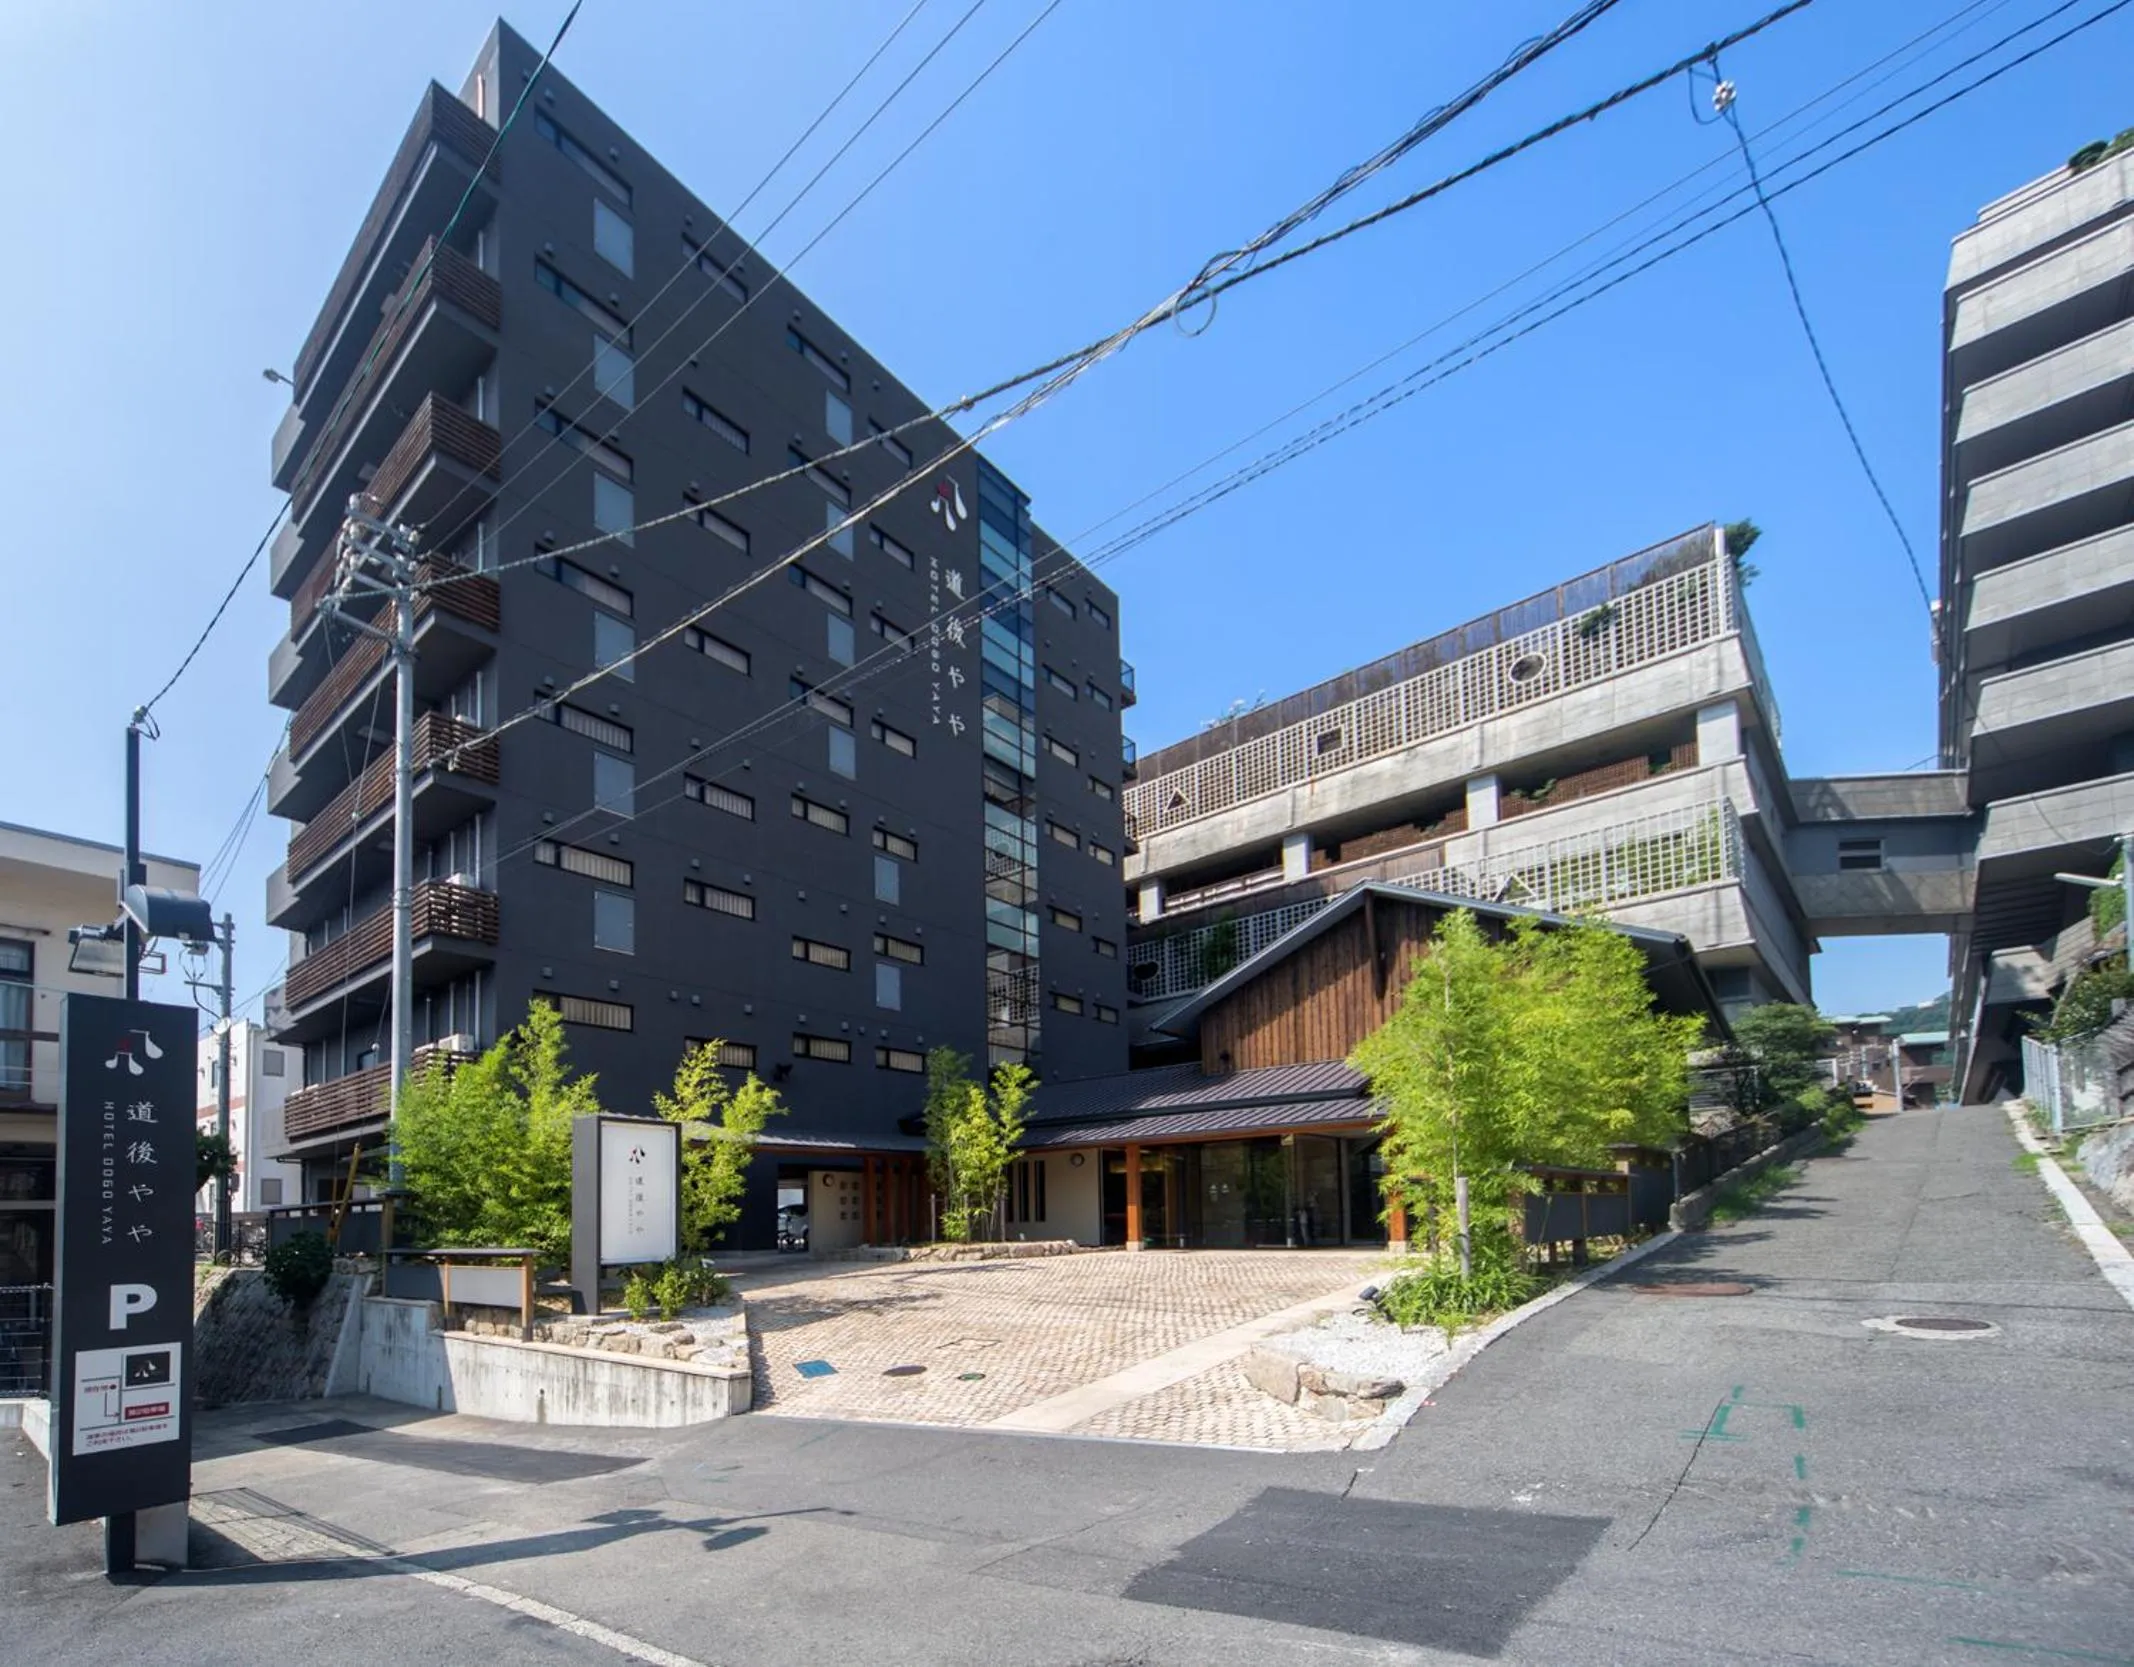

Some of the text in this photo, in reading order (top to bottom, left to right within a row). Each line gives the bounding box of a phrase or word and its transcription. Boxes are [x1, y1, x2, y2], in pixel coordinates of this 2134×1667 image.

[101, 1101, 115, 1245] HOTEL DOGO YAYA
[126, 1101, 158, 1243] 道後やや
[109, 1283, 158, 1330] P
